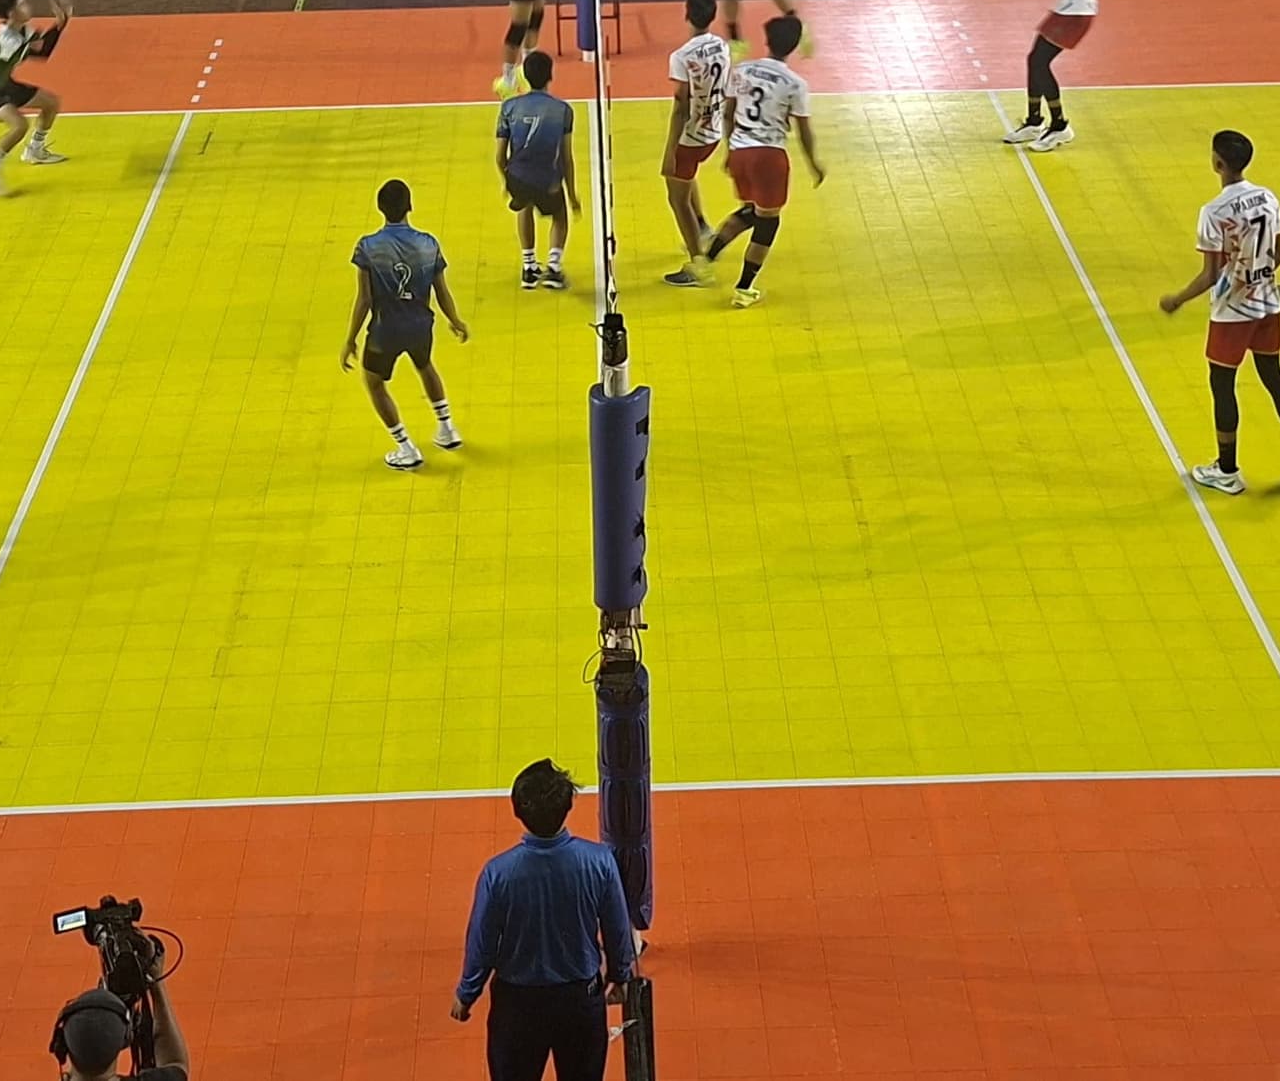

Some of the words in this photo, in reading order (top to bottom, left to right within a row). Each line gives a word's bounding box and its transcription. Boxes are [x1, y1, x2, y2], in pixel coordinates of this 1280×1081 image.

[746, 87, 764, 121] 3
[523, 116, 540, 149] 7
[1250, 215, 1266, 258] 7
[394, 262, 413, 300] 2
